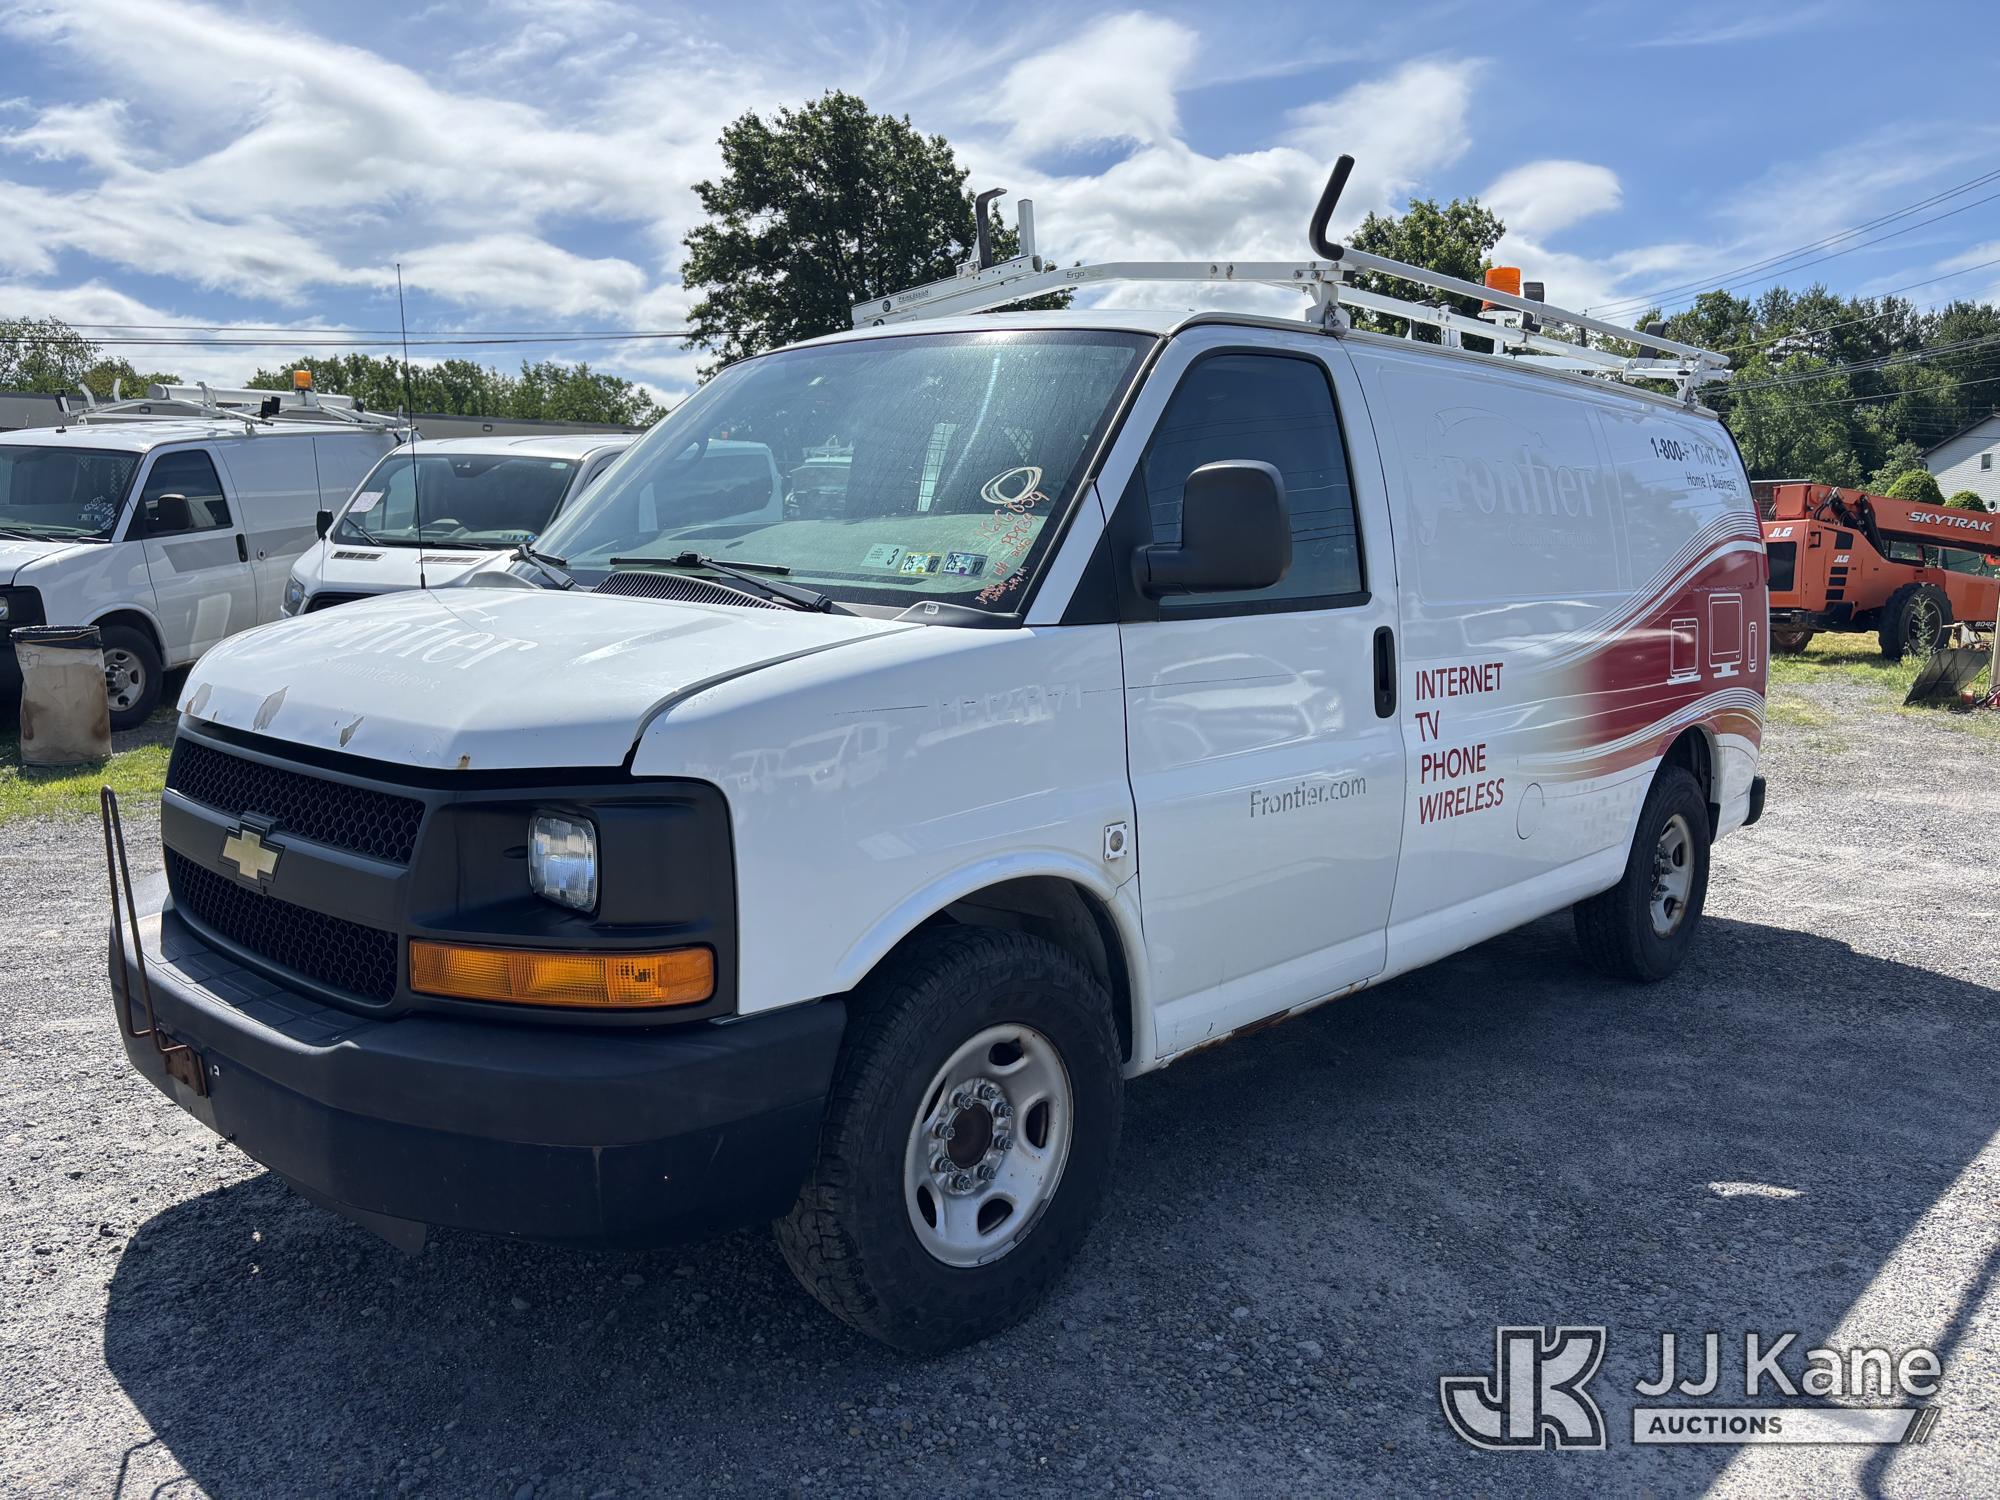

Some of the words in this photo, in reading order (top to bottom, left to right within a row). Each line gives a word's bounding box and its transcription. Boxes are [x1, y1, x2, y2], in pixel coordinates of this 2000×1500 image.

[1685, 471, 1706, 488] Home
[1712, 474, 1737, 491] Business
[1909, 511, 1993, 532] SKYTRAK
[1768, 527, 1793, 538] JLG
[886, 548, 900, 565] 3
[903, 555, 916, 571] 25
[927, 558, 940, 573] 12
[945, 554, 960, 571] 25
[970, 560, 984, 576] 12
[1833, 554, 1850, 563] JLG
[1416, 662, 1504, 701] INTERNET
[1415, 710, 1440, 742] TV
[1421, 743, 1487, 785] PHONE
[1250, 777, 1367, 818] Frontier.com
[1419, 777, 1505, 825] WIRELESS
